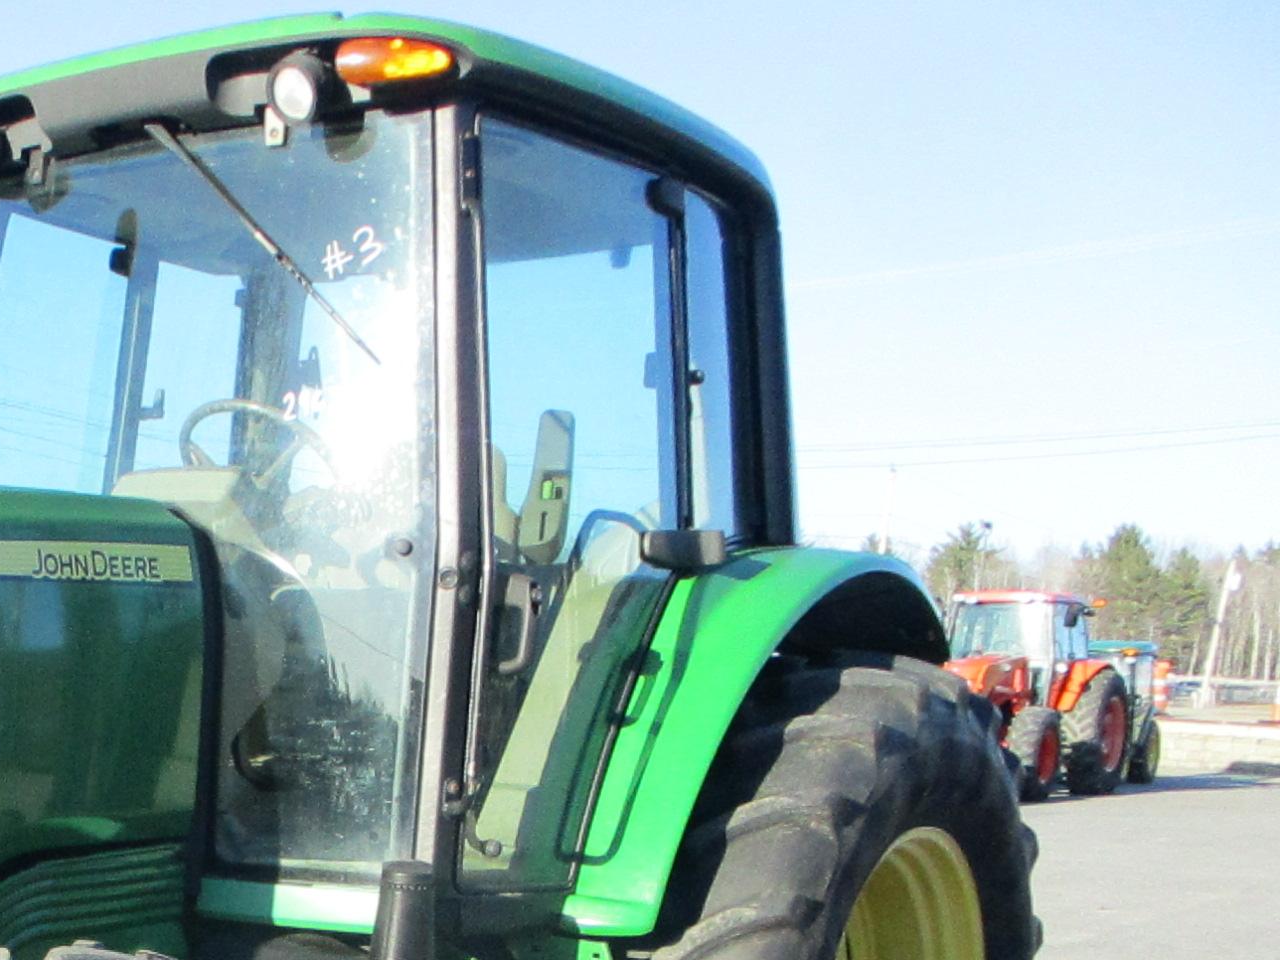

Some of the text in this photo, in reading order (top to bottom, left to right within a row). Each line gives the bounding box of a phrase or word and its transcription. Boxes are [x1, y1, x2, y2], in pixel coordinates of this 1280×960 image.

[322, 224, 384, 278] #3
[32, 549, 161, 579] JOHN DEERE
